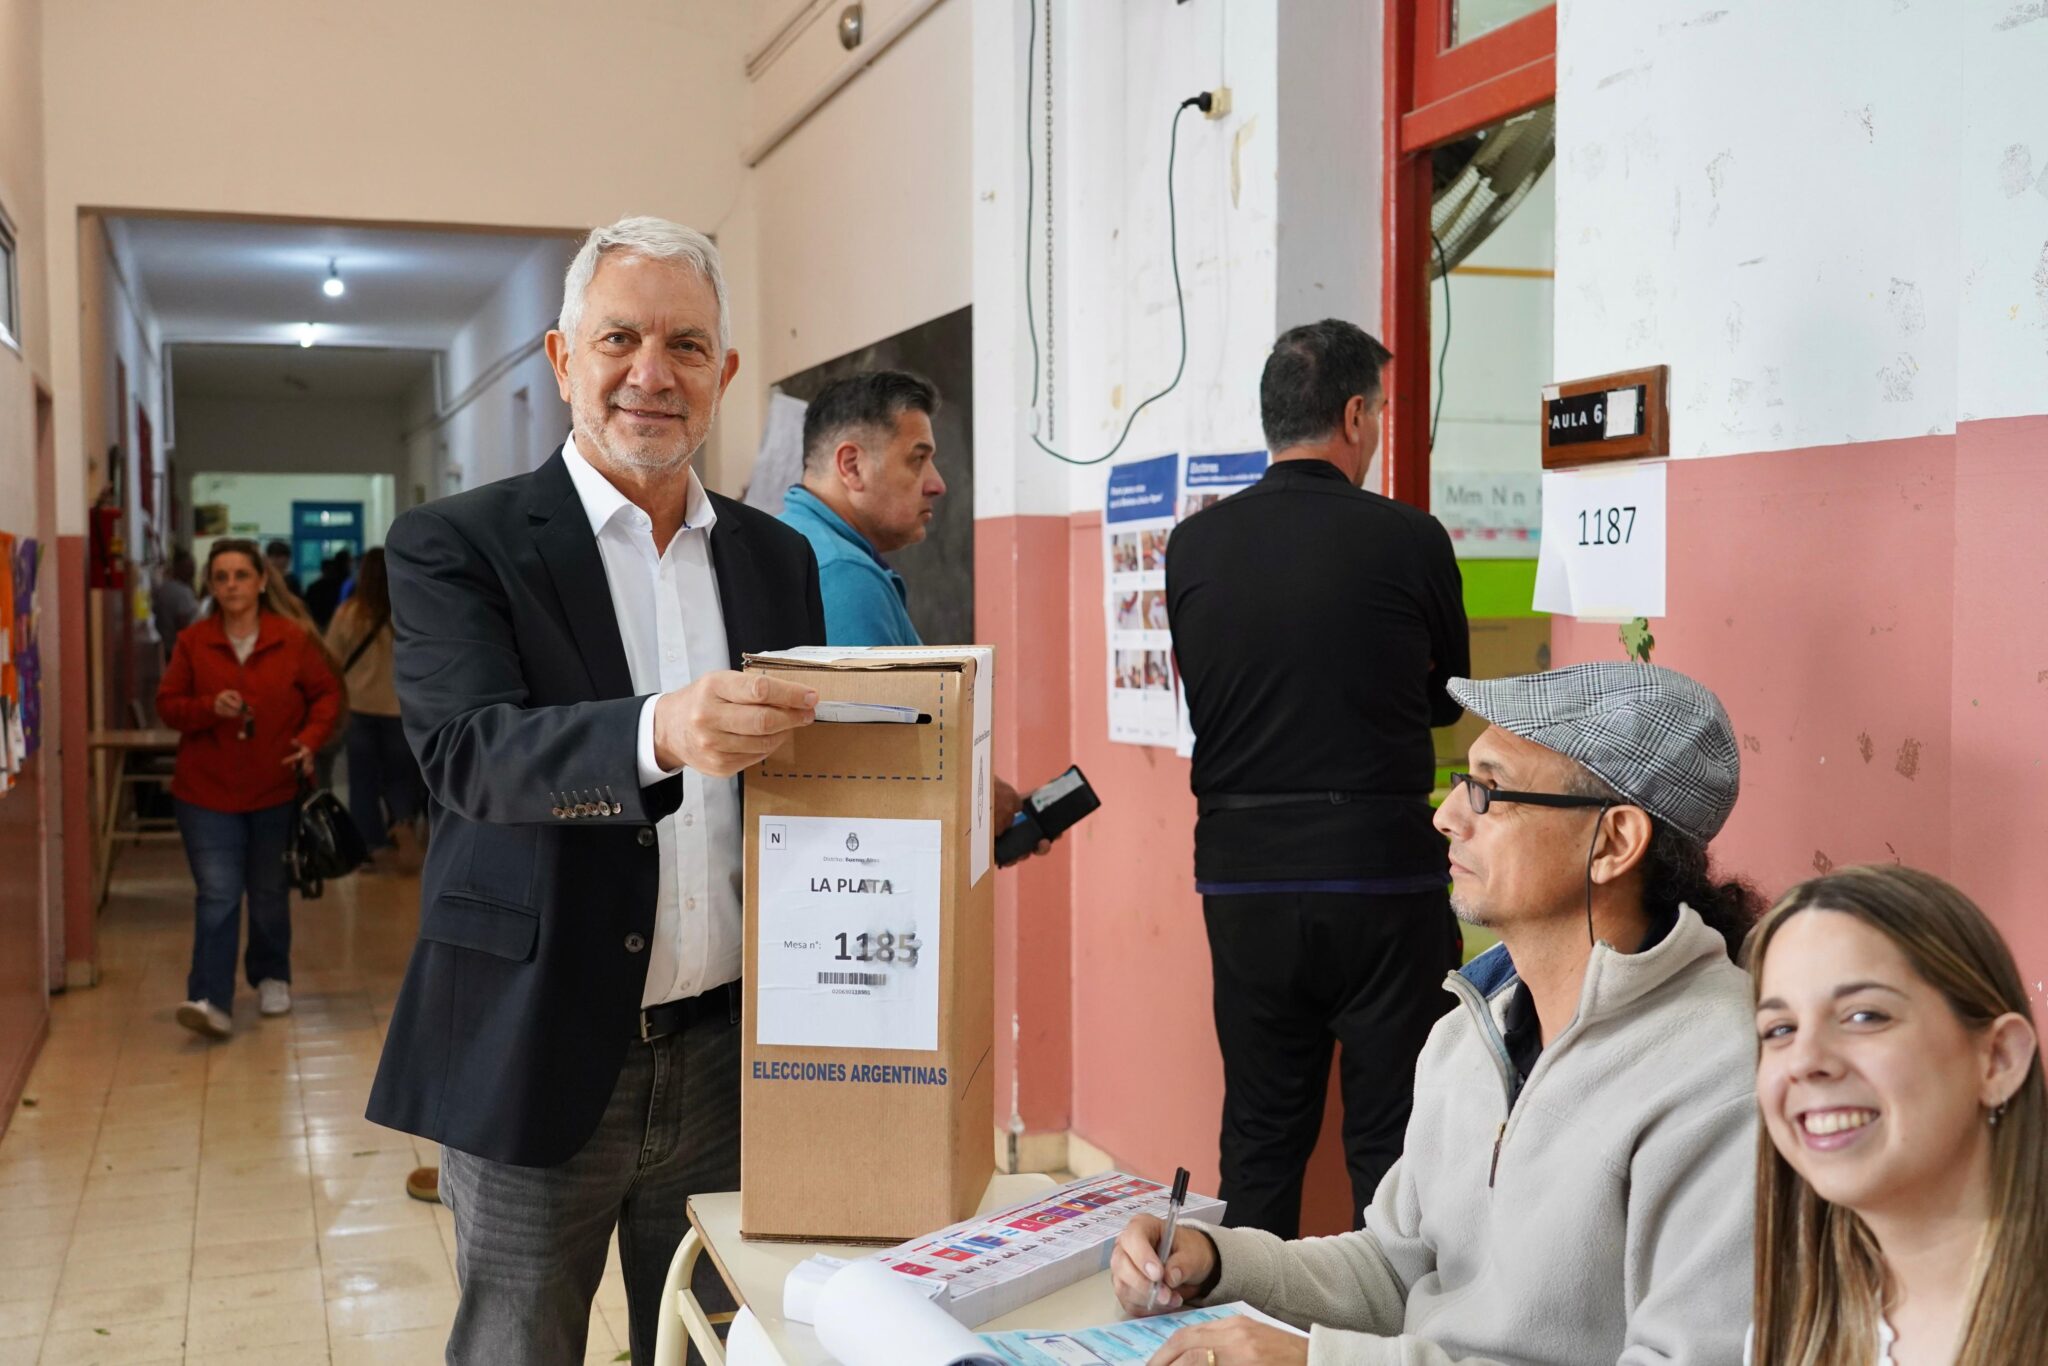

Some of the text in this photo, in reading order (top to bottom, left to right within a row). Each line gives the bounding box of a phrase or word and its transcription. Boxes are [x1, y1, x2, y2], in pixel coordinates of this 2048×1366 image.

[1552, 403, 1603, 429] AULA 6
[1578, 506, 1637, 546] 1187
[771, 833, 781, 844] N
[810, 877, 893, 895] LA PLATA
[783, 940, 808, 950] Mesa
[834, 932, 919, 964] 1185
[752, 1061, 947, 1086] ELECCIONES ARGENTINAS
